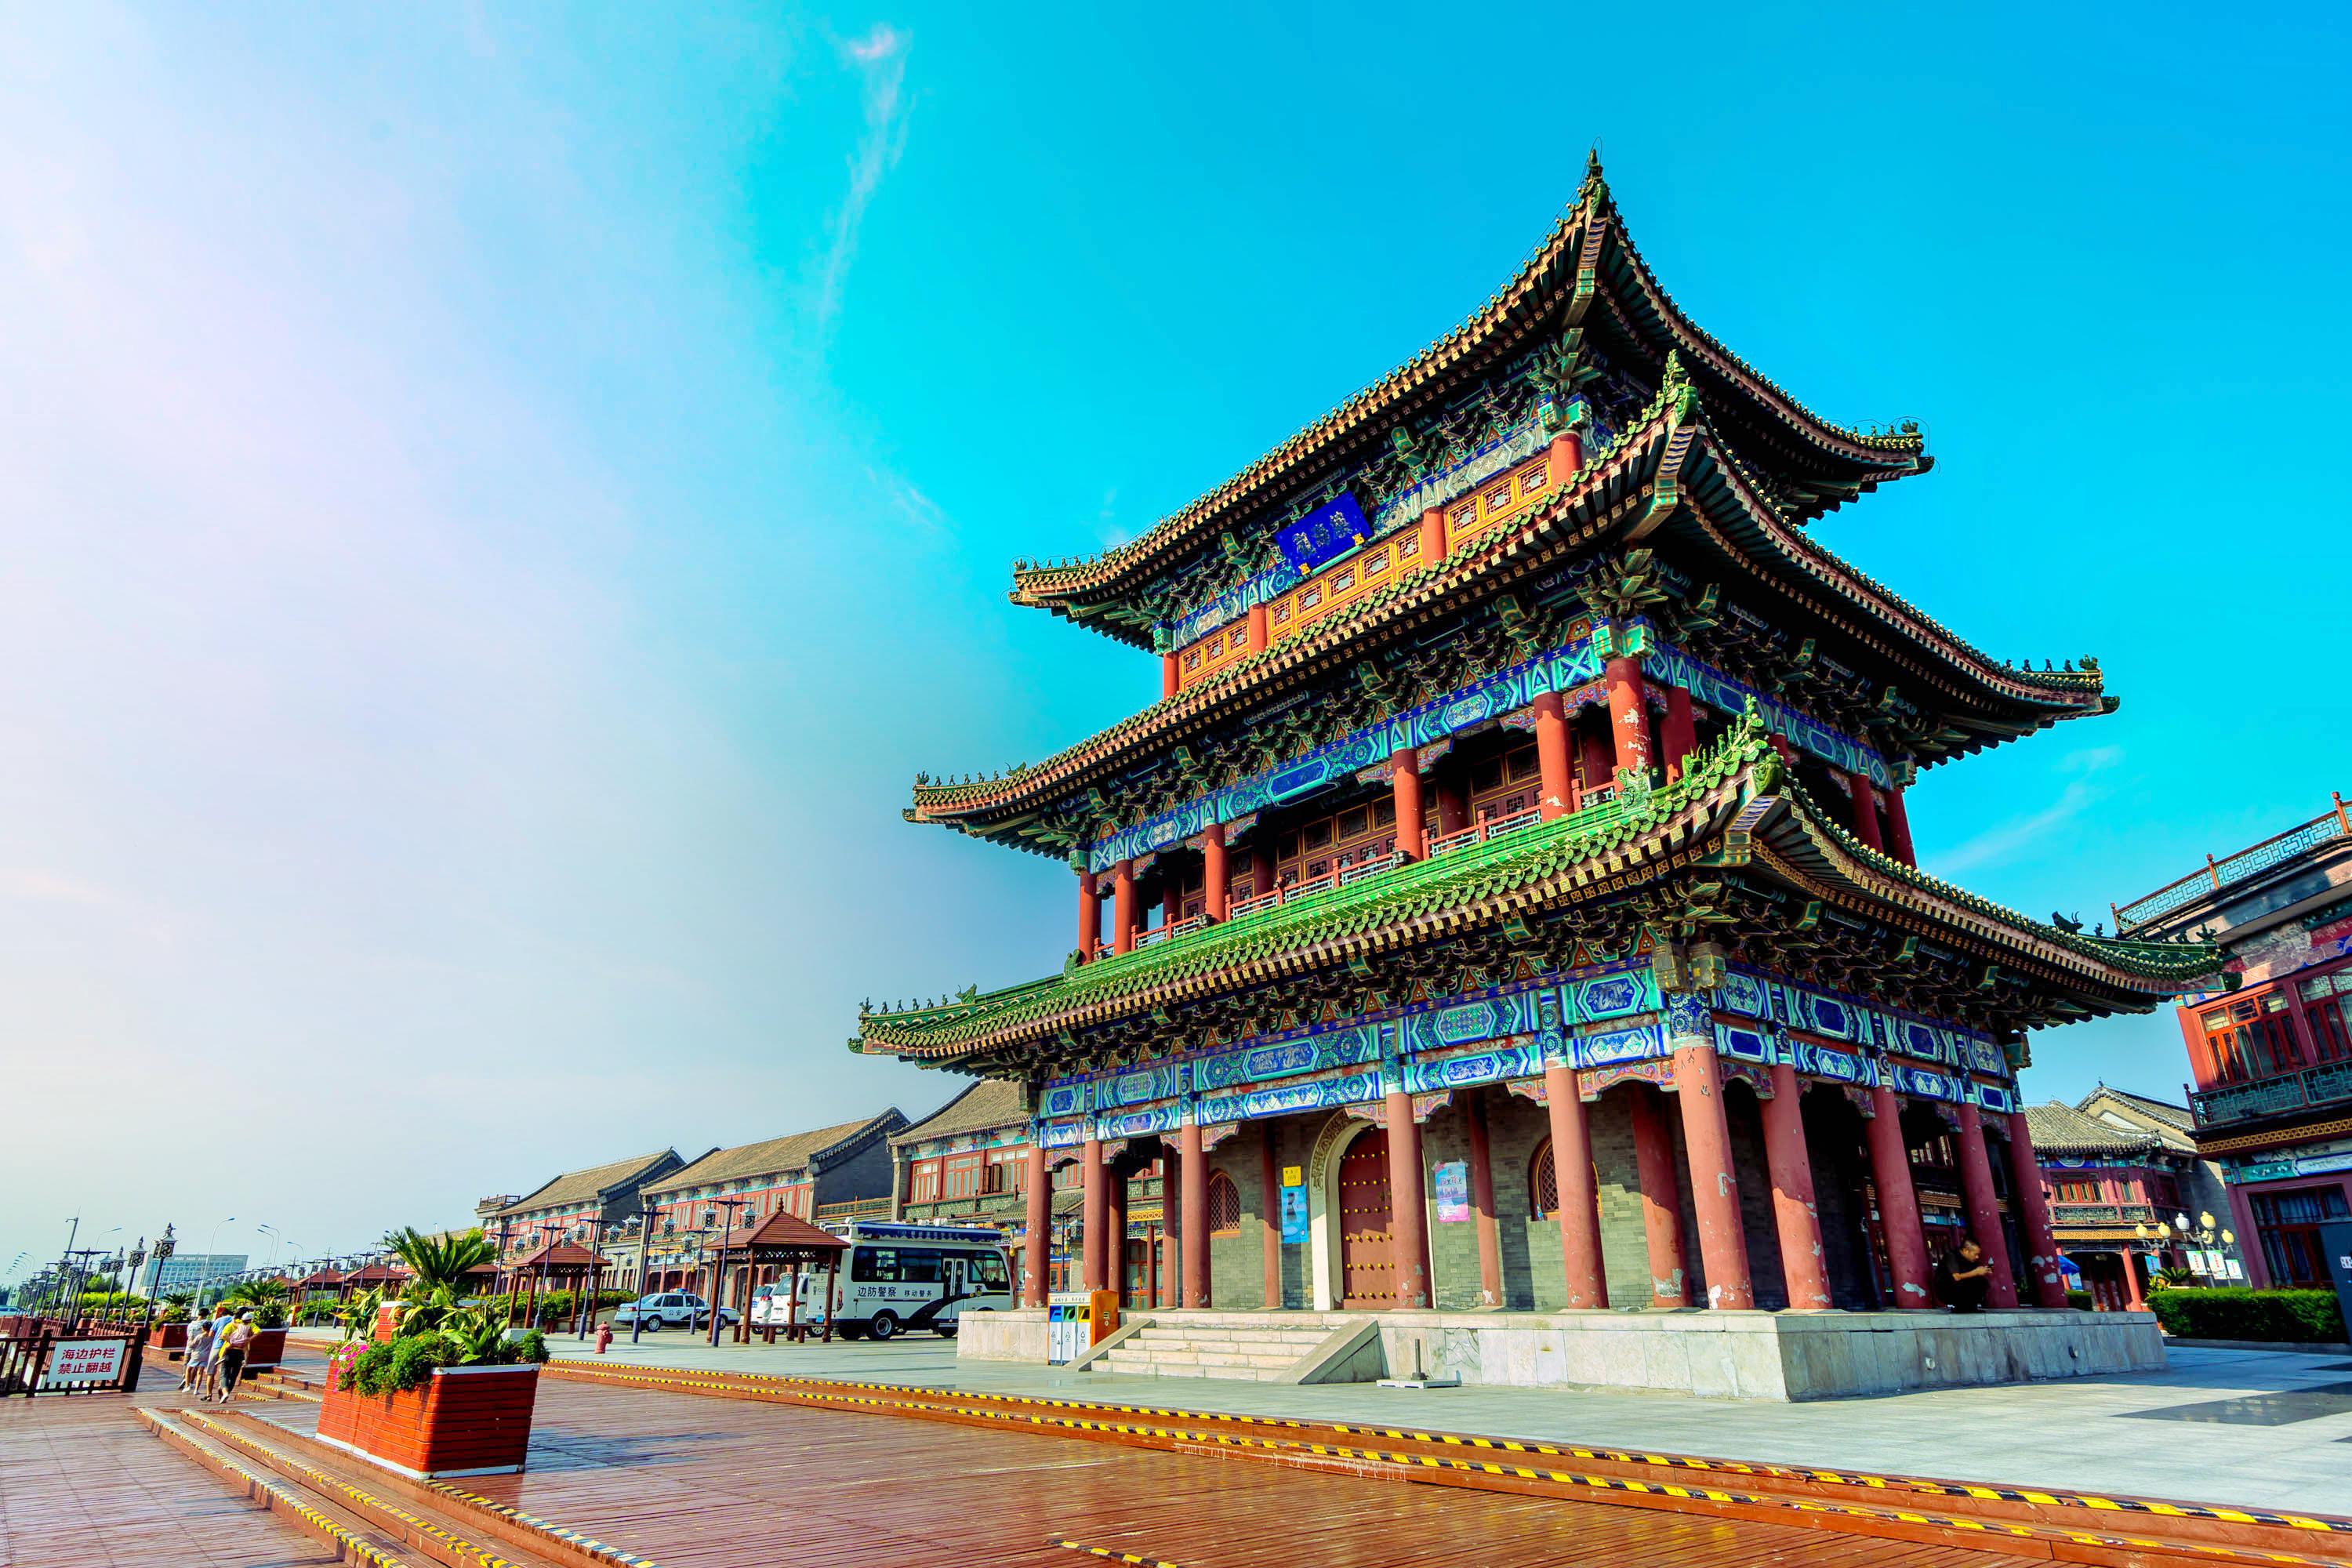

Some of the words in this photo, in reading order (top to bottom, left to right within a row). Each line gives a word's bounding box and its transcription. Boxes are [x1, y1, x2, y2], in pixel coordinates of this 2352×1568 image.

[858, 1287, 897, 1298] 边防警察
[61, 1348, 115, 1360] 海边护栏
[58, 1362, 112, 1374] 禁止翻越
